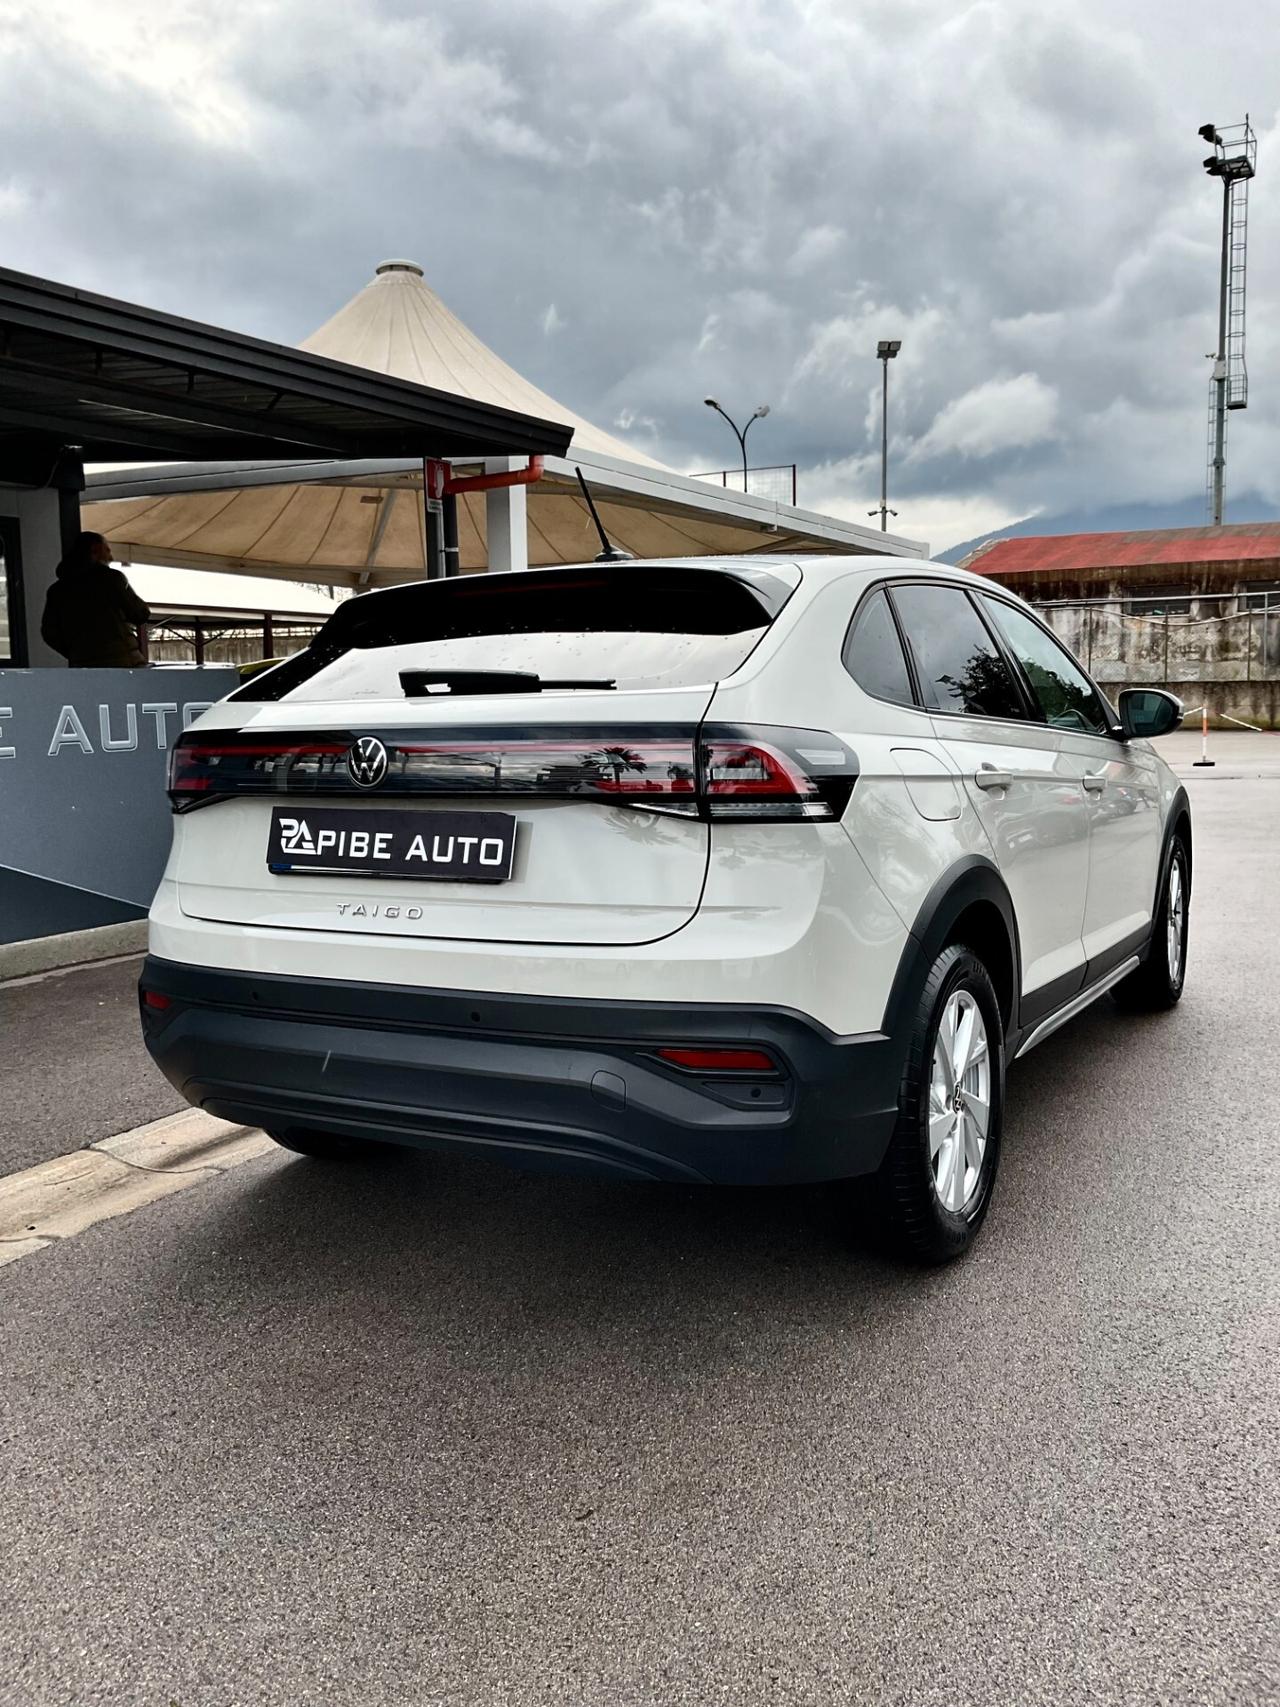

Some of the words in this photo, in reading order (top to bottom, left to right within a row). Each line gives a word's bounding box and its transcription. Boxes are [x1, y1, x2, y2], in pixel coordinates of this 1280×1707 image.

[317, 830, 393, 859] PIBE
[405, 834, 504, 866] AUTO
[336, 903, 424, 920] TAIGO
